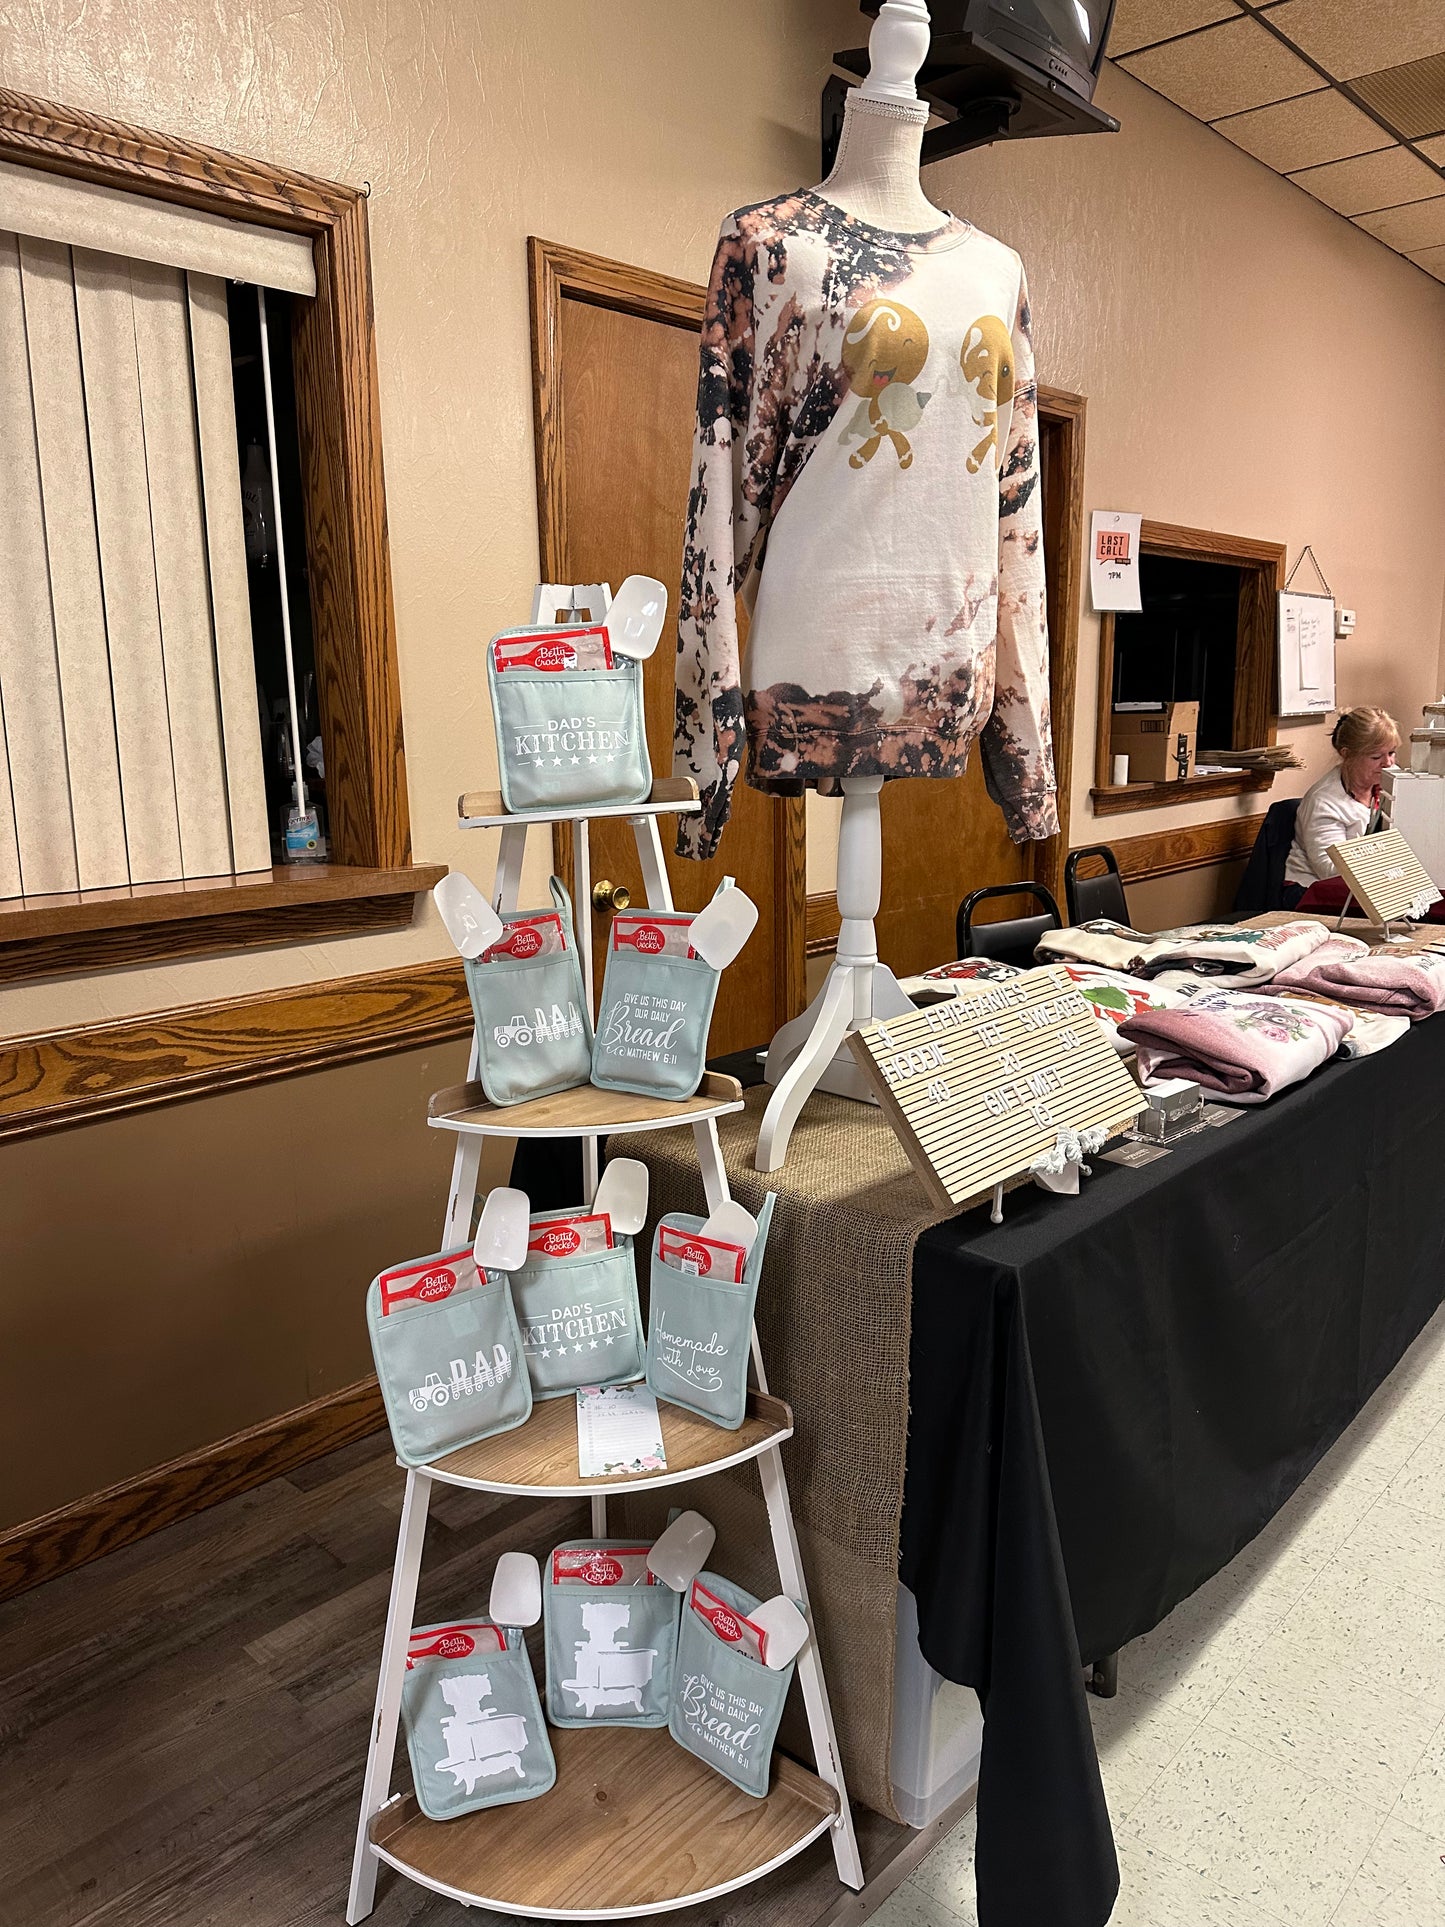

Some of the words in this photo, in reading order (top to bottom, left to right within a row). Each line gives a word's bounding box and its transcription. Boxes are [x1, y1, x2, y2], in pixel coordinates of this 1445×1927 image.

[1100, 545, 1123, 556] CALL
[1101, 535, 1124, 546] LAST
[535, 656, 565, 668] Crocke
[547, 716, 596, 731] DAD'S
[514, 730, 630, 756] KITCHEN
[514, 933, 536, 946] Betty
[638, 930, 658, 942] Betty
[511, 943, 540, 954] Crocker
[624, 992, 639, 1004] GIVE
[640, 996, 650, 1006] US
[652, 996, 668, 1009] THIS
[670, 1000, 687, 1012] DAY
[923, 983, 1029, 1033] EPIPHANIES
[601, 1000, 685, 1049] Bread
[635, 1008, 649, 1019] OUR
[651, 1010, 671, 1022] DAILY
[880, 1042, 954, 1085] HOODIE
[973, 1022, 1010, 1049] TEE
[1018, 991, 1090, 1032] SWEATER
[627, 1047, 661, 1061] MATTHEW
[663, 1053, 677, 1064] 6:11
[926, 1077, 950, 1104] 40
[998, 1052, 1022, 1076] 20
[1056, 1029, 1081, 1051] 30
[983, 1081, 1027, 1117] GIFT
[1023, 1066, 1065, 1098] MITT
[1029, 1103, 1053, 1130] 10
[684, 1246, 705, 1263] Betty
[420, 1283, 453, 1298] Crocker
[422, 1273, 448, 1289] Betty
[551, 1303, 592, 1321] DAD'S
[522, 1308, 628, 1346] KITCHEN
[655, 1307, 728, 1356] Homemade
[449, 1344, 508, 1384] DAD
[686, 1350, 720, 1380] Love
[713, 1616, 741, 1639] Crocker
[716, 1610, 736, 1631] Betty
[439, 1636, 465, 1648] Betty
[439, 1645, 472, 1655] Crocker
[701, 1674, 715, 1693] GIVE
[715, 1687, 726, 1700] US
[728, 1693, 747, 1708] THIS
[748, 1702, 764, 1717] DAY
[680, 1673, 760, 1751] Bread
[710, 1697, 725, 1712] OUR
[727, 1706, 749, 1723] DAILY
[703, 1730, 737, 1759] MATTHEW
[737, 1753, 749, 1769] 6:11
